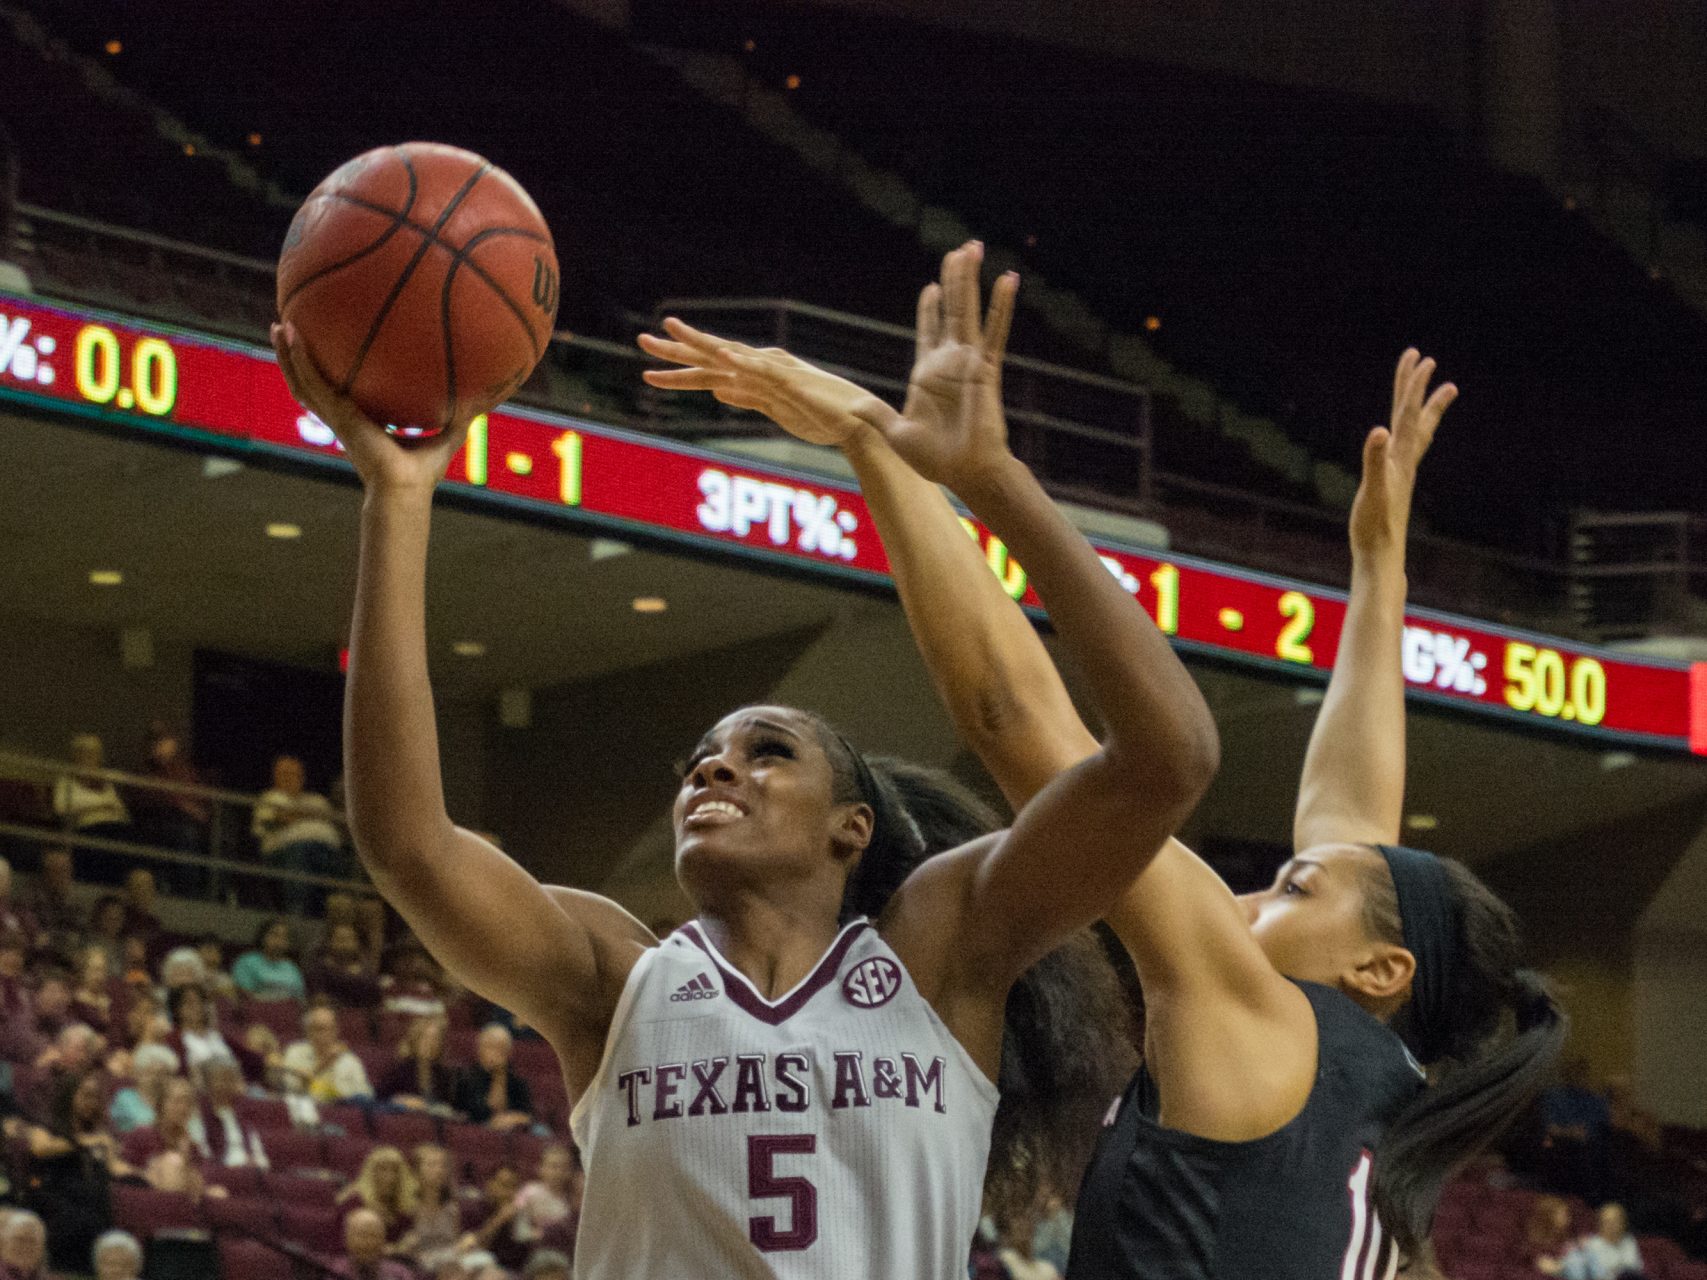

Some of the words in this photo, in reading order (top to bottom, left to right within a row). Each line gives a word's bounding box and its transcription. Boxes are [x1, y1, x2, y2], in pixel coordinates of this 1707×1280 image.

[75, 324, 177, 416] 0.0
[551, 430, 582, 506] 1
[697, 469, 857, 560] 3PT%:
[1151, 563, 1179, 636] 1
[1275, 591, 1315, 664] 2
[1402, 626, 1487, 695] G%:
[1504, 641, 1606, 725] 50.0
[847, 959, 898, 1005] SEC
[618, 1053, 810, 1128] TEXAS
[832, 1051, 947, 1115] A&M
[747, 1133, 819, 1253] 5
